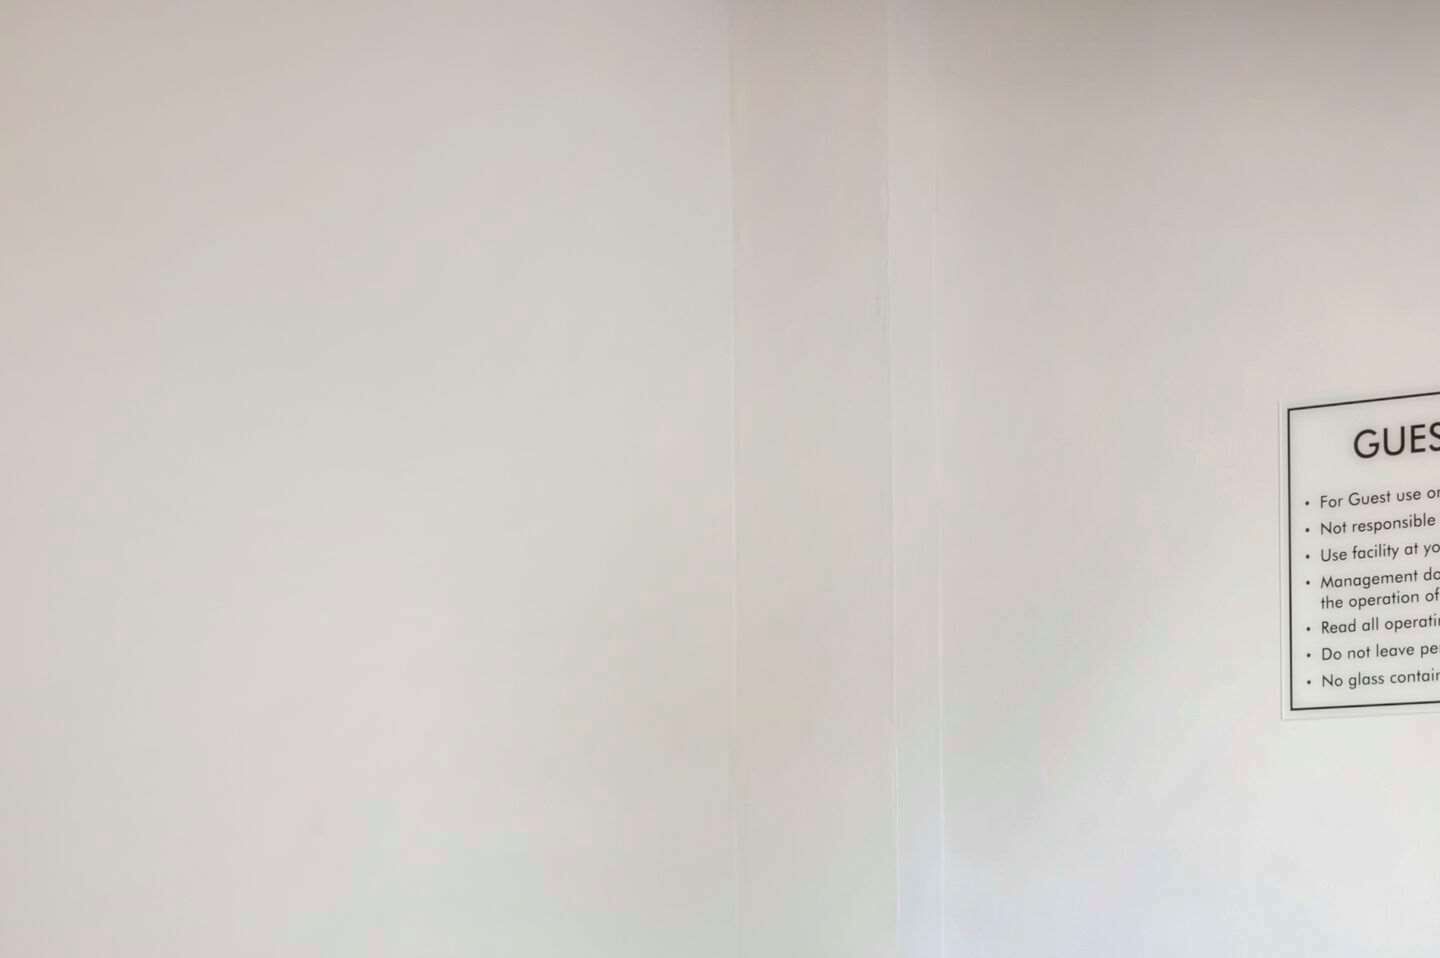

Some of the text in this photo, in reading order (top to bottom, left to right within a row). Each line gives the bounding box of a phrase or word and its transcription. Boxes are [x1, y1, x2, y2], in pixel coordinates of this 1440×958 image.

[1320, 494, 1344, 509] For
[1348, 490, 1391, 506] Guest
[1396, 488, 1422, 502] use
[1320, 522, 1347, 535] Not
[1352, 512, 1436, 534] responsible
[1321, 548, 1347, 563] Use
[1352, 542, 1399, 562] facility
[1404, 542, 1419, 556] at
[1320, 569, 1418, 590] Management
[1320, 595, 1344, 610] the
[1349, 590, 1420, 612] operation
[1424, 588, 1440, 602] of
[1321, 619, 1356, 635] Read
[1362, 618, 1379, 631] all
[1321, 647, 1342, 661] Do
[1347, 647, 1371, 660] not
[1376, 642, 1415, 658] leave
[1322, 674, 1344, 688] No
[1348, 670, 1384, 691] glass
